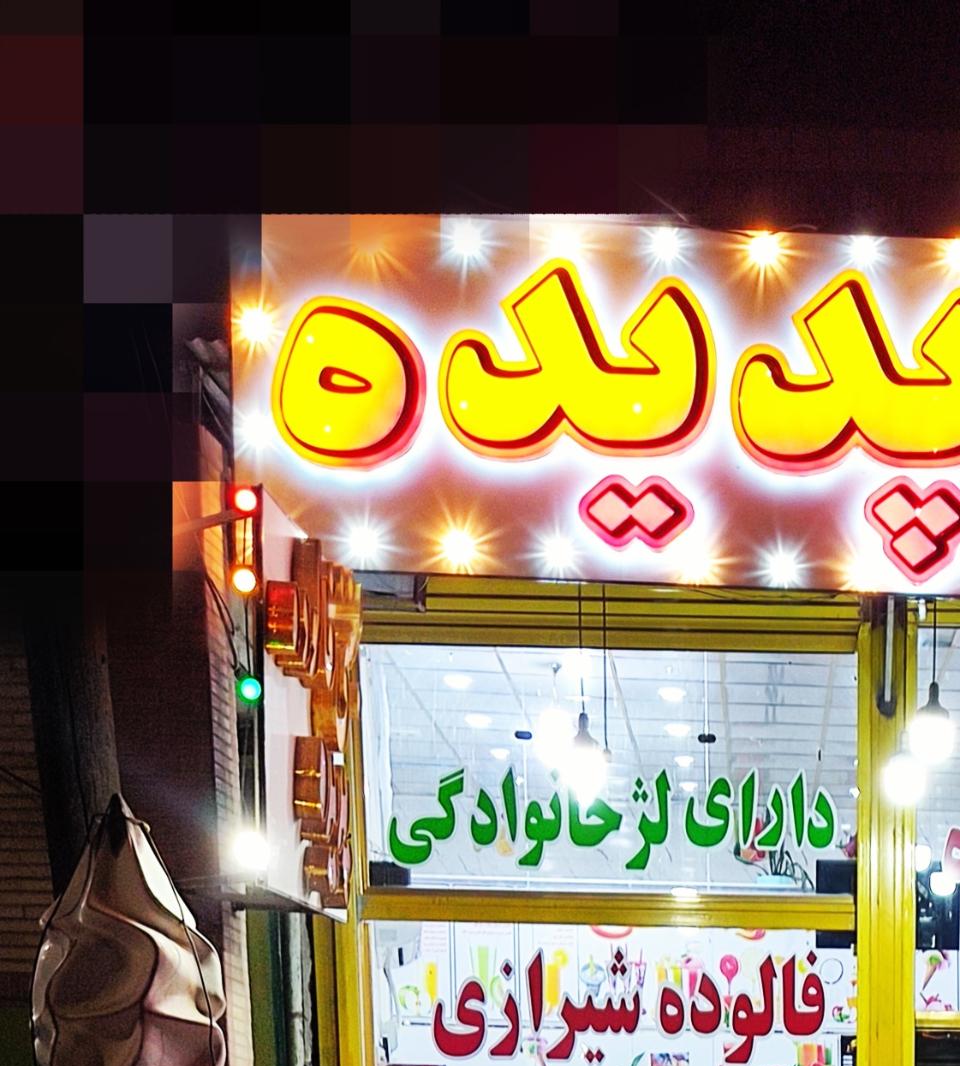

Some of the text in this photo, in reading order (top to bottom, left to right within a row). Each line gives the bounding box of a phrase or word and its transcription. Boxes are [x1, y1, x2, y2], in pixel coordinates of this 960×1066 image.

[389, 766, 836, 870] دارای لژ خانوادگی
[432, 947, 827, 1065] فالوده شیرازی
